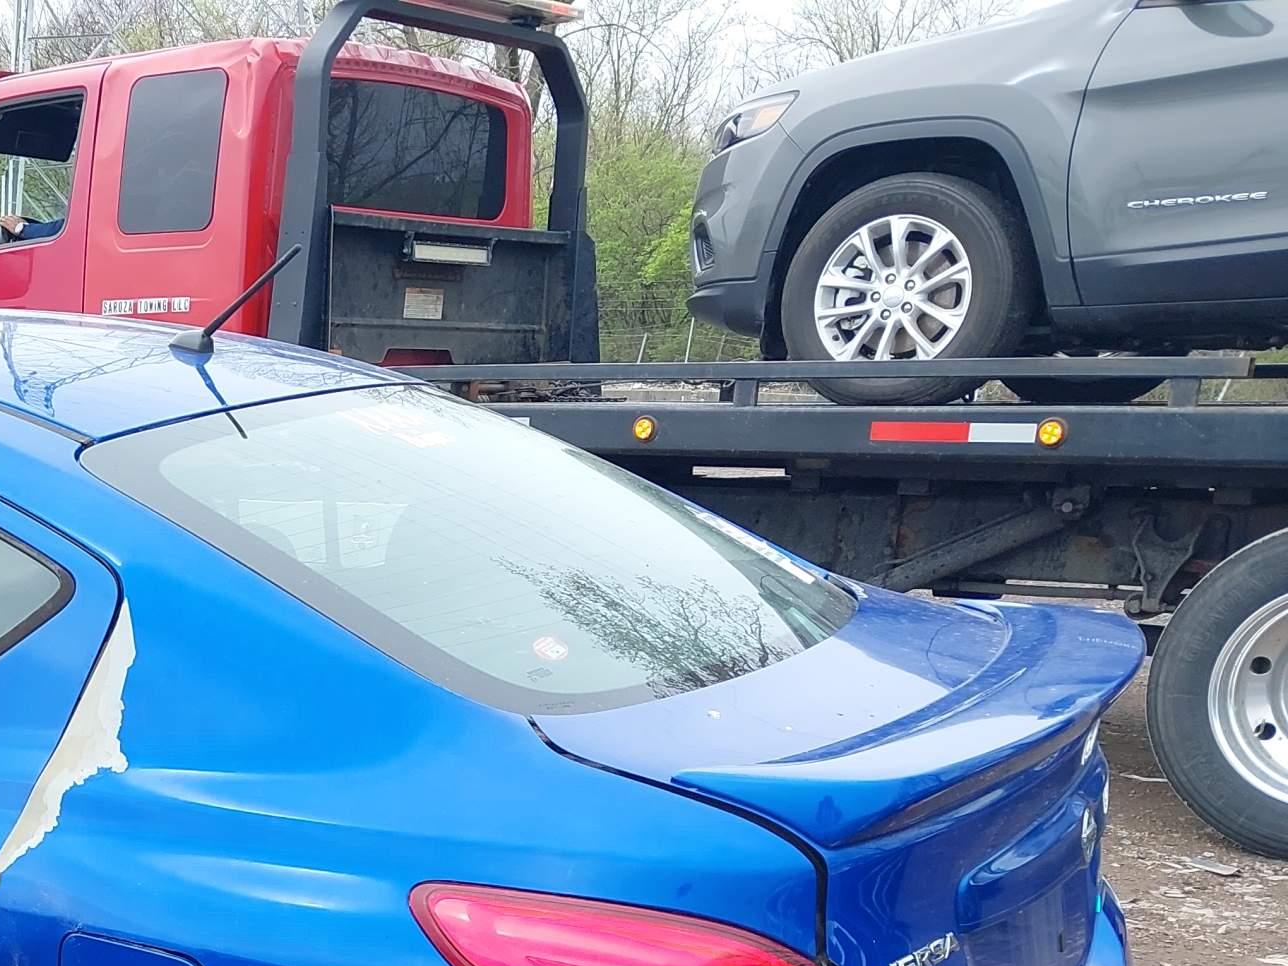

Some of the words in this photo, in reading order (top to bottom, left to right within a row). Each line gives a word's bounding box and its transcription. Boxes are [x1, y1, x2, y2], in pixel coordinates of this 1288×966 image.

[1126, 190, 1268, 209] CHEROKEE
[102, 301, 133, 314] SAROZA
[138, 299, 167, 312] TOWING
[172, 298, 189, 311] LLC
